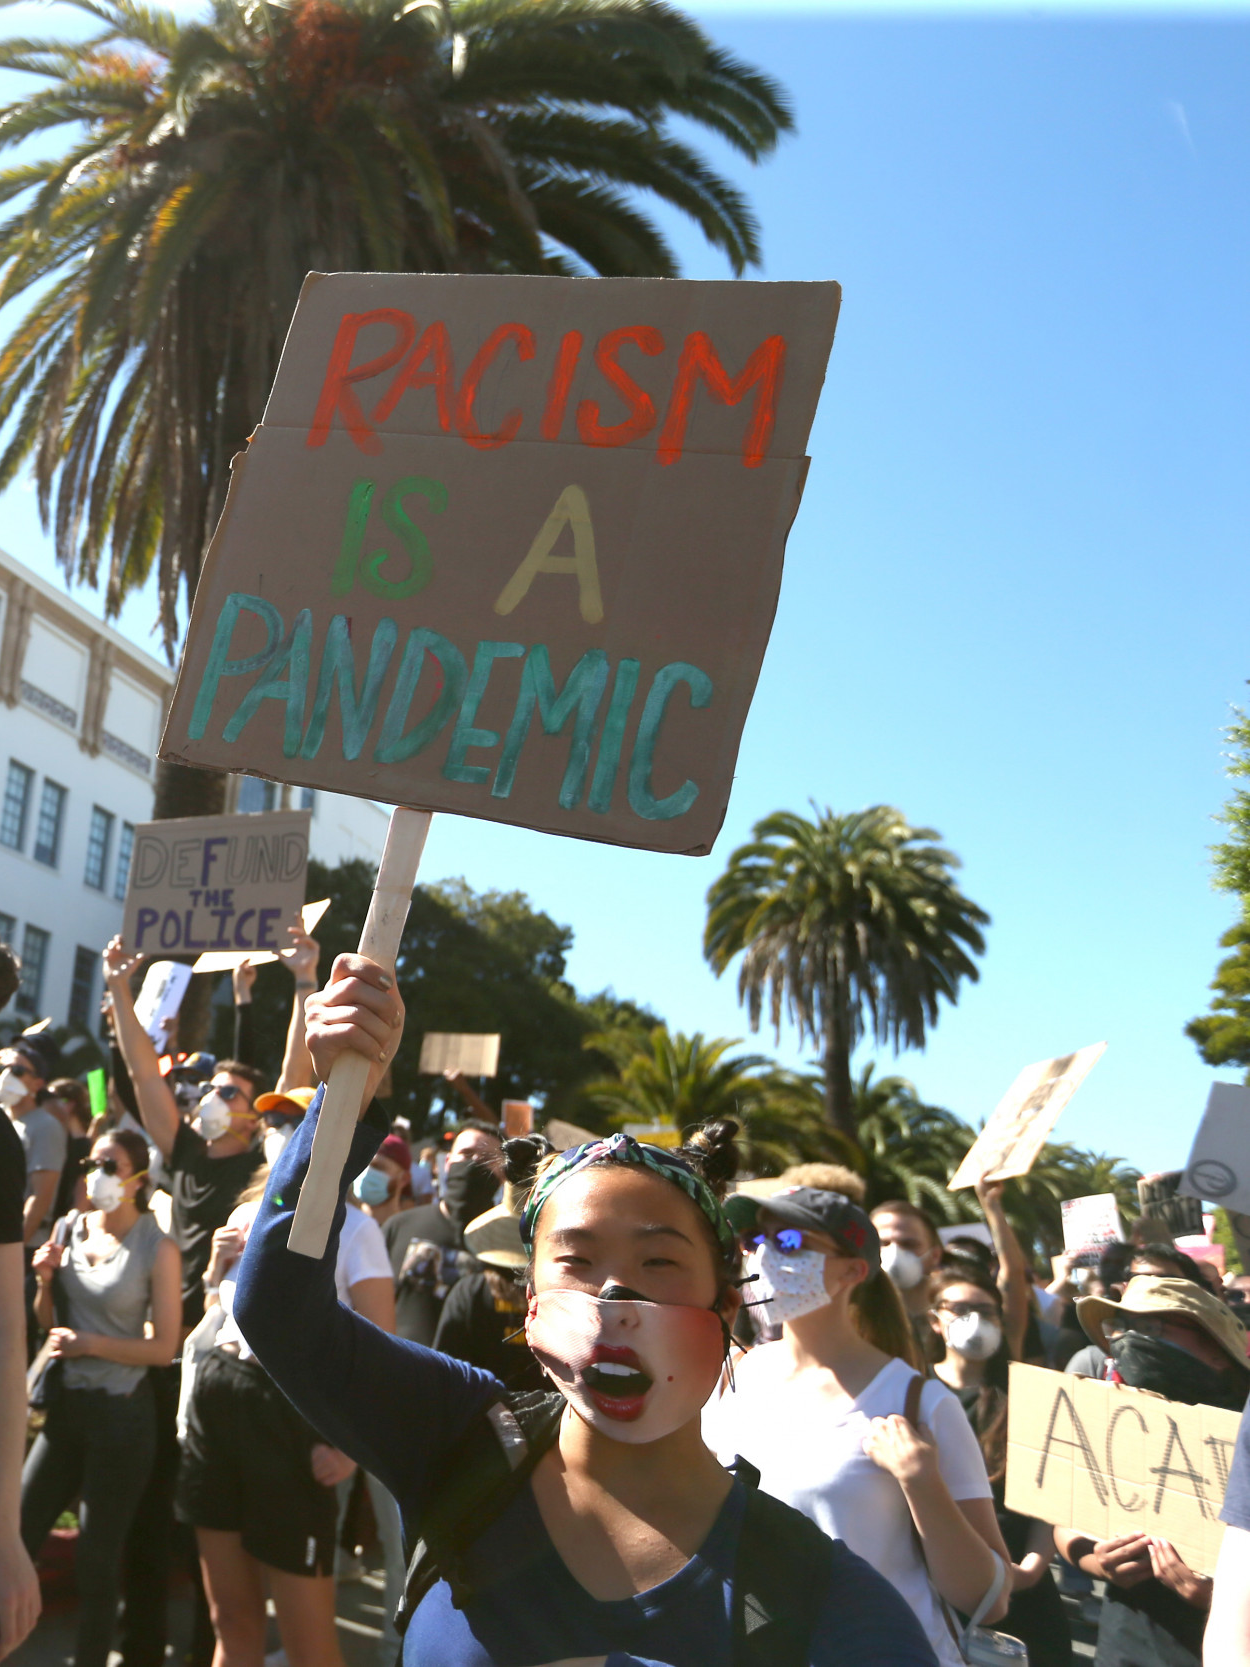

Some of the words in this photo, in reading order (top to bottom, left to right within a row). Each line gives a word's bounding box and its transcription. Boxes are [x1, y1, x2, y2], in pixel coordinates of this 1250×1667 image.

[305, 307, 787, 468] RACISM
[330, 475, 449, 599] IS
[494, 484, 604, 625] A
[187, 591, 713, 821] PANDEMIC
[132, 831, 309, 890] DEFUND
[189, 888, 235, 908] THE
[134, 907, 282, 949] POLICE
